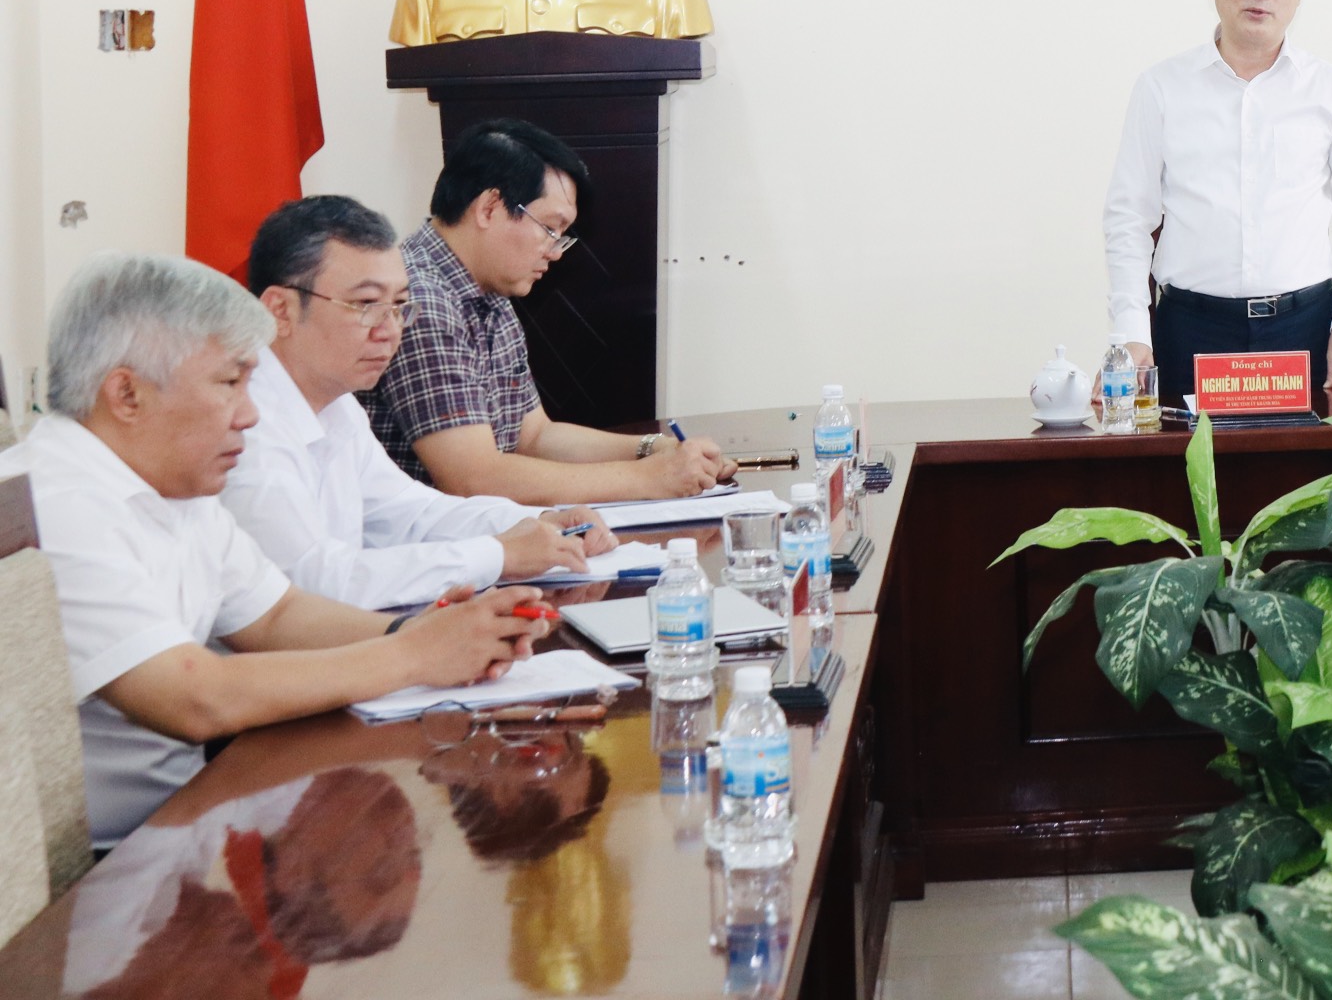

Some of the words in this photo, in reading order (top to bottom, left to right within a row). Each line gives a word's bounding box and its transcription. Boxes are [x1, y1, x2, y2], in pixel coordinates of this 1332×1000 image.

[1202, 374, 1240, 393] NGHIÊM
[1242, 373, 1269, 392] XUÂN
[1271, 372, 1304, 391] THÀNH
